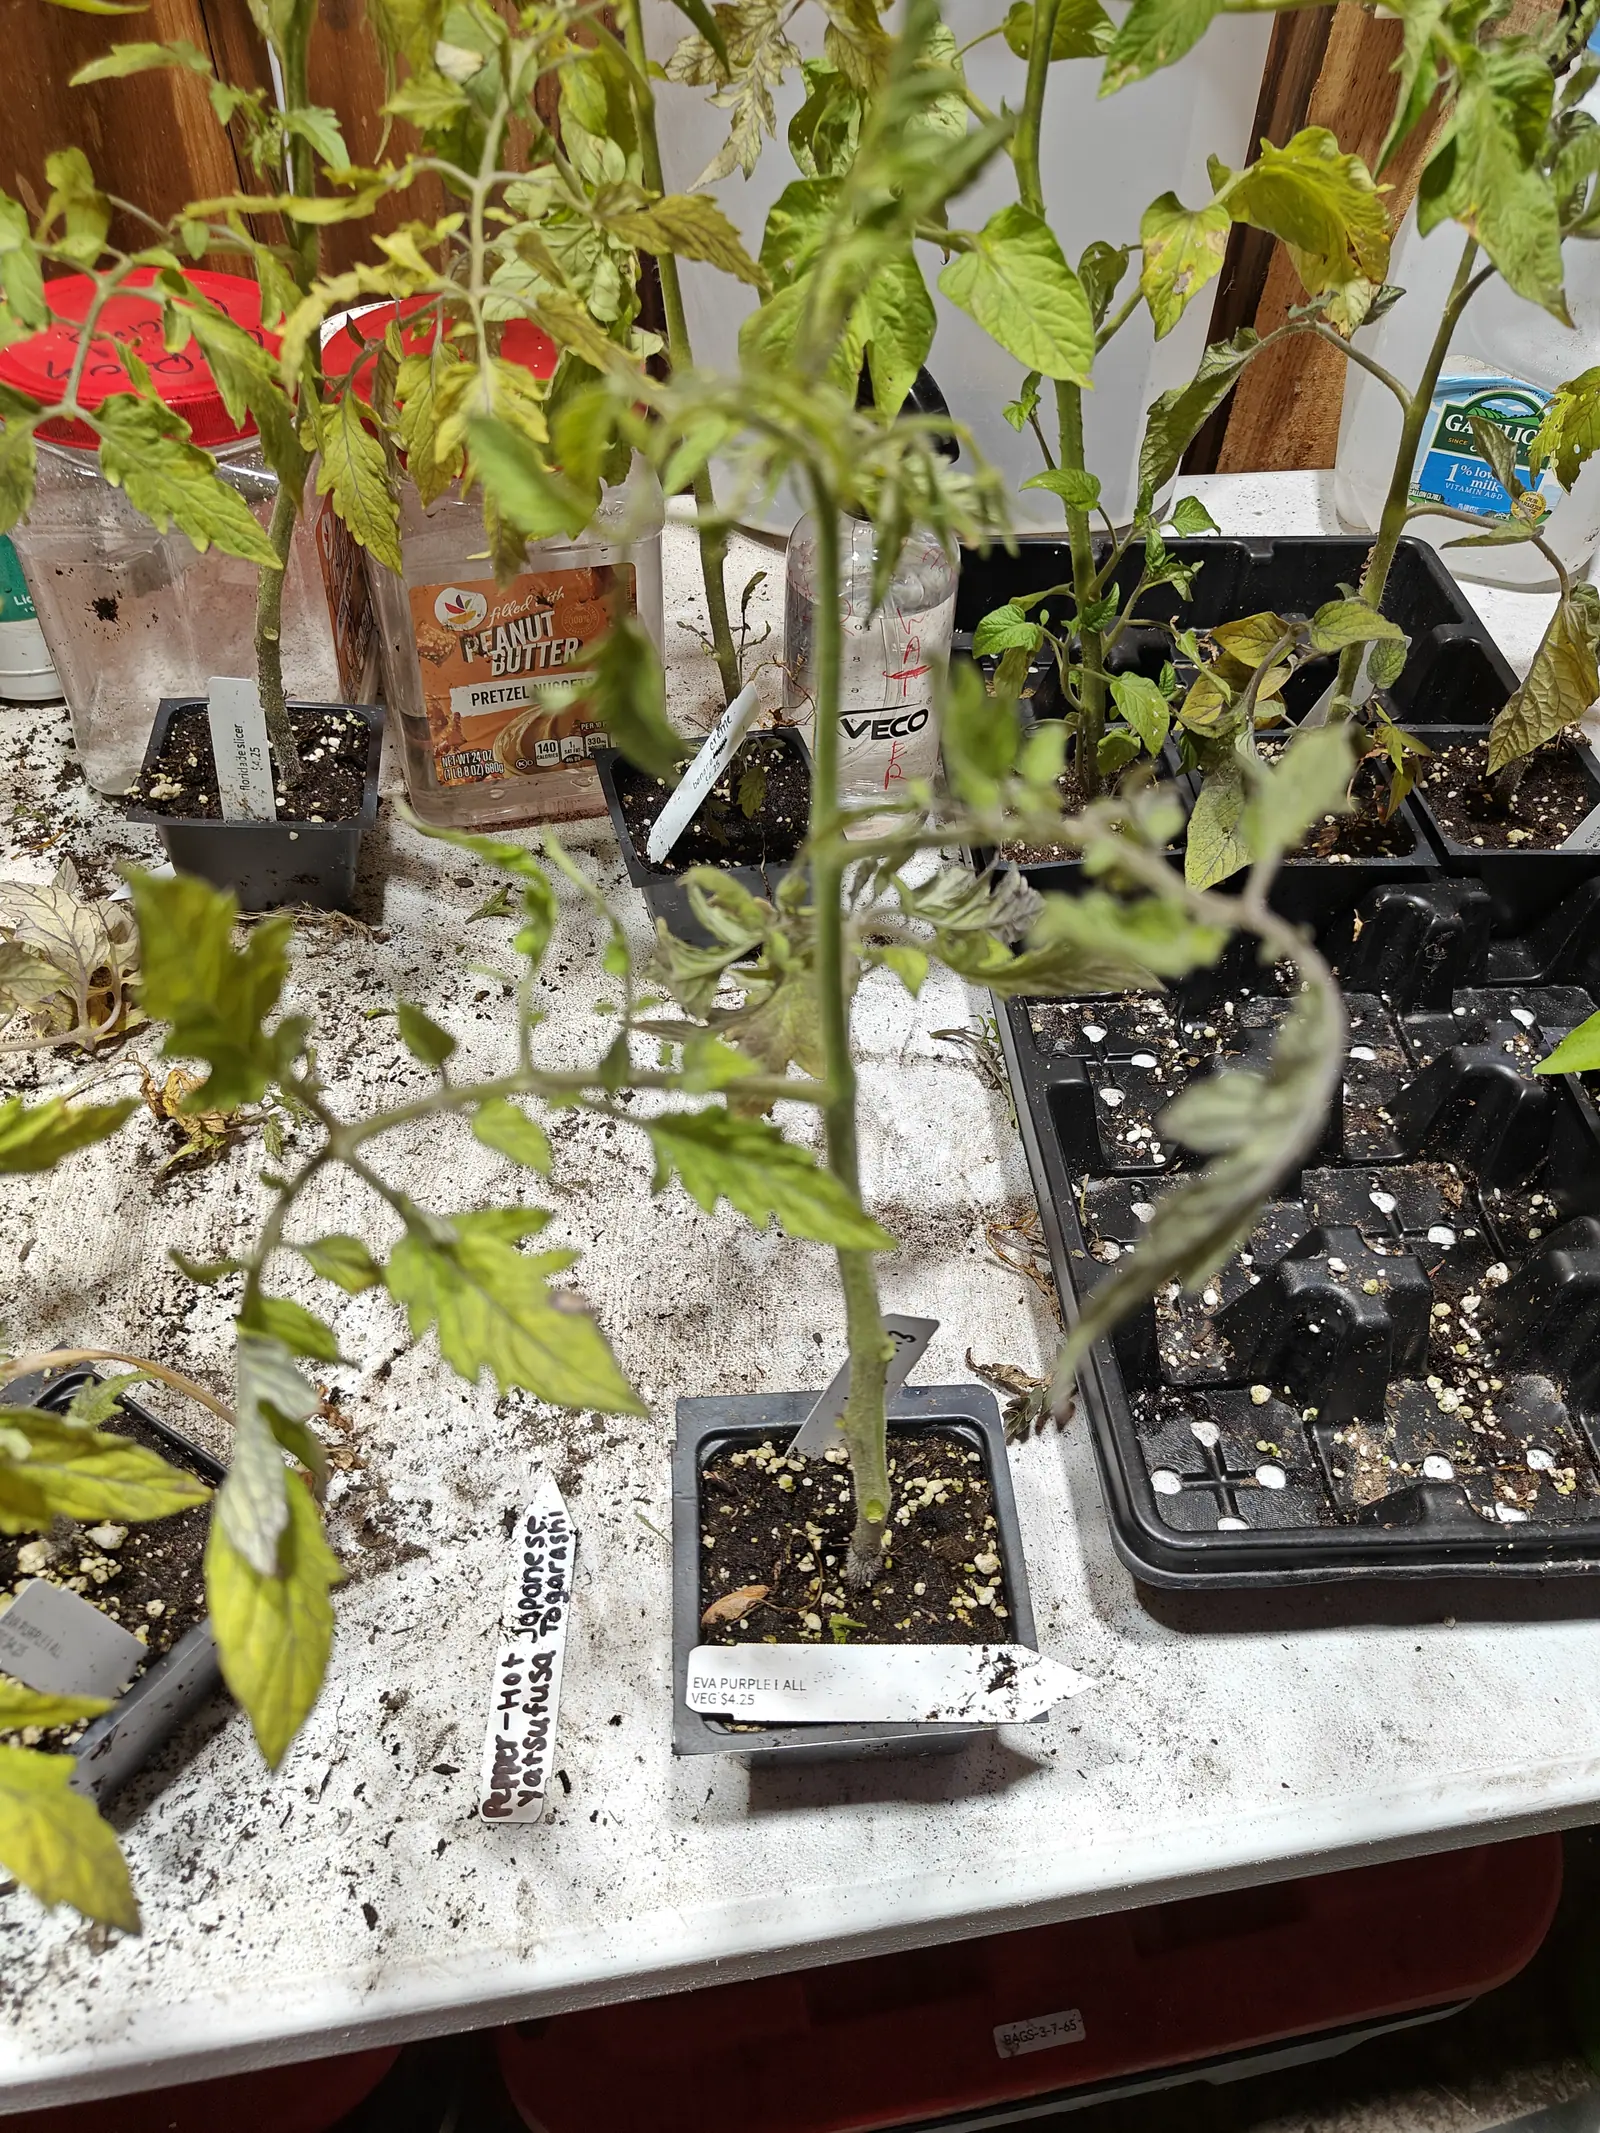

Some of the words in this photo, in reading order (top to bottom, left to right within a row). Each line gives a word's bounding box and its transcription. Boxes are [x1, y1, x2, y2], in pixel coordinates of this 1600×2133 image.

[1445, 414, 1538, 445] GALIC
[1447, 437, 1469, 446] SINCE
[1445, 463, 1472, 483] 1%
[1445, 482, 1483, 496] VITAMIN
[1484, 491, 1504, 501] A&D
[1470, 479, 1500, 493] milk
[489, 595, 533, 628] filled
[464, 610, 556, 664] PEANUT
[491, 637, 580, 677] BUTTER
[471, 685, 530, 706] PRETZEL
[537, 742, 557, 754] 140
[537, 752, 558, 760] CALORIES
[442, 756, 457, 768] NET
[456, 753, 470, 765] WT
[471, 751, 481, 762] 24
[482, 750, 494, 761] OZ
[483, 1734, 522, 1818] Pepper
[514, 1514, 547, 1644] Japanese
[693, 1676, 717, 1689] EVA
[720, 1678, 771, 1691] PURPLE
[691, 1692, 717, 1705] VEG
[720, 1692, 755, 1706] $4.25
